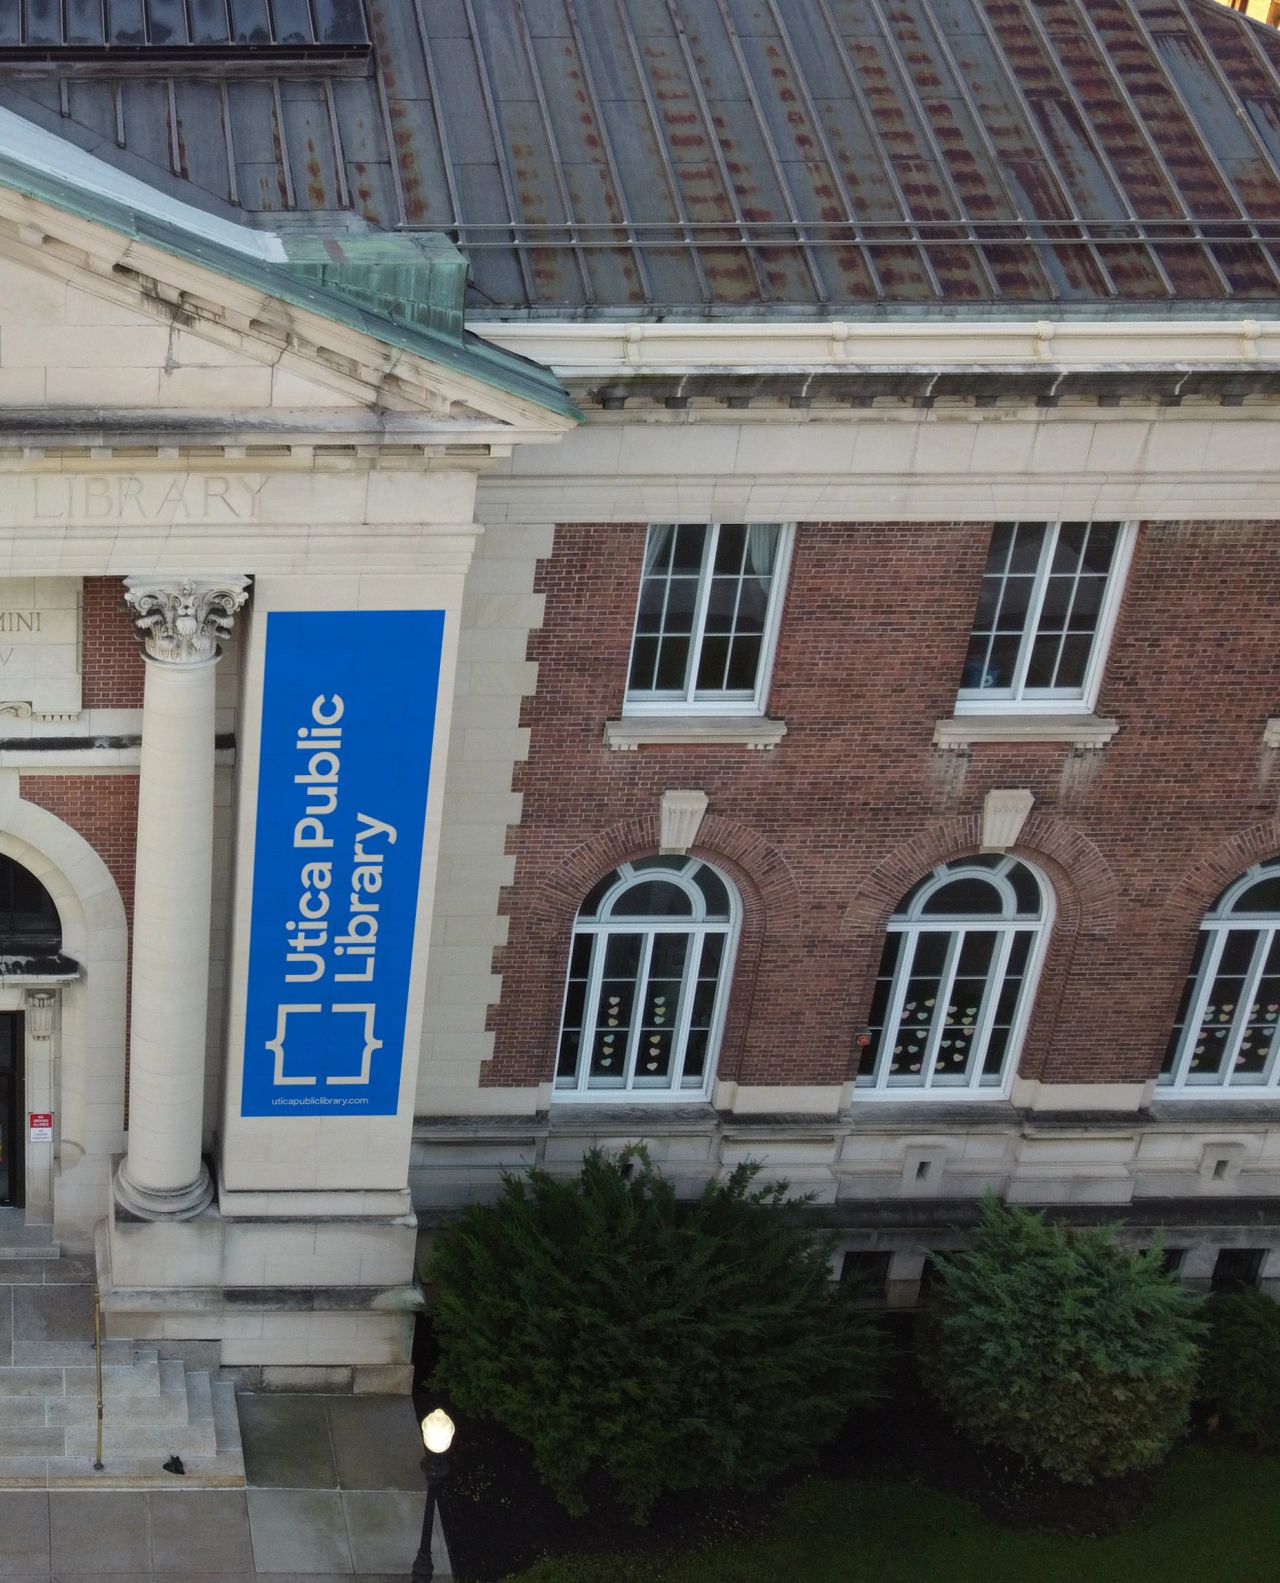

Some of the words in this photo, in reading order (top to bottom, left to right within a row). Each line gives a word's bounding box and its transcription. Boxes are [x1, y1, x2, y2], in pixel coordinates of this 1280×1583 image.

[31, 475, 271, 519] LIBRARY
[293, 693, 345, 848] Public
[284, 861, 333, 983] Utica
[333, 812, 398, 982] Library
[271, 1096, 369, 1106] uticapubliclibrary.com
